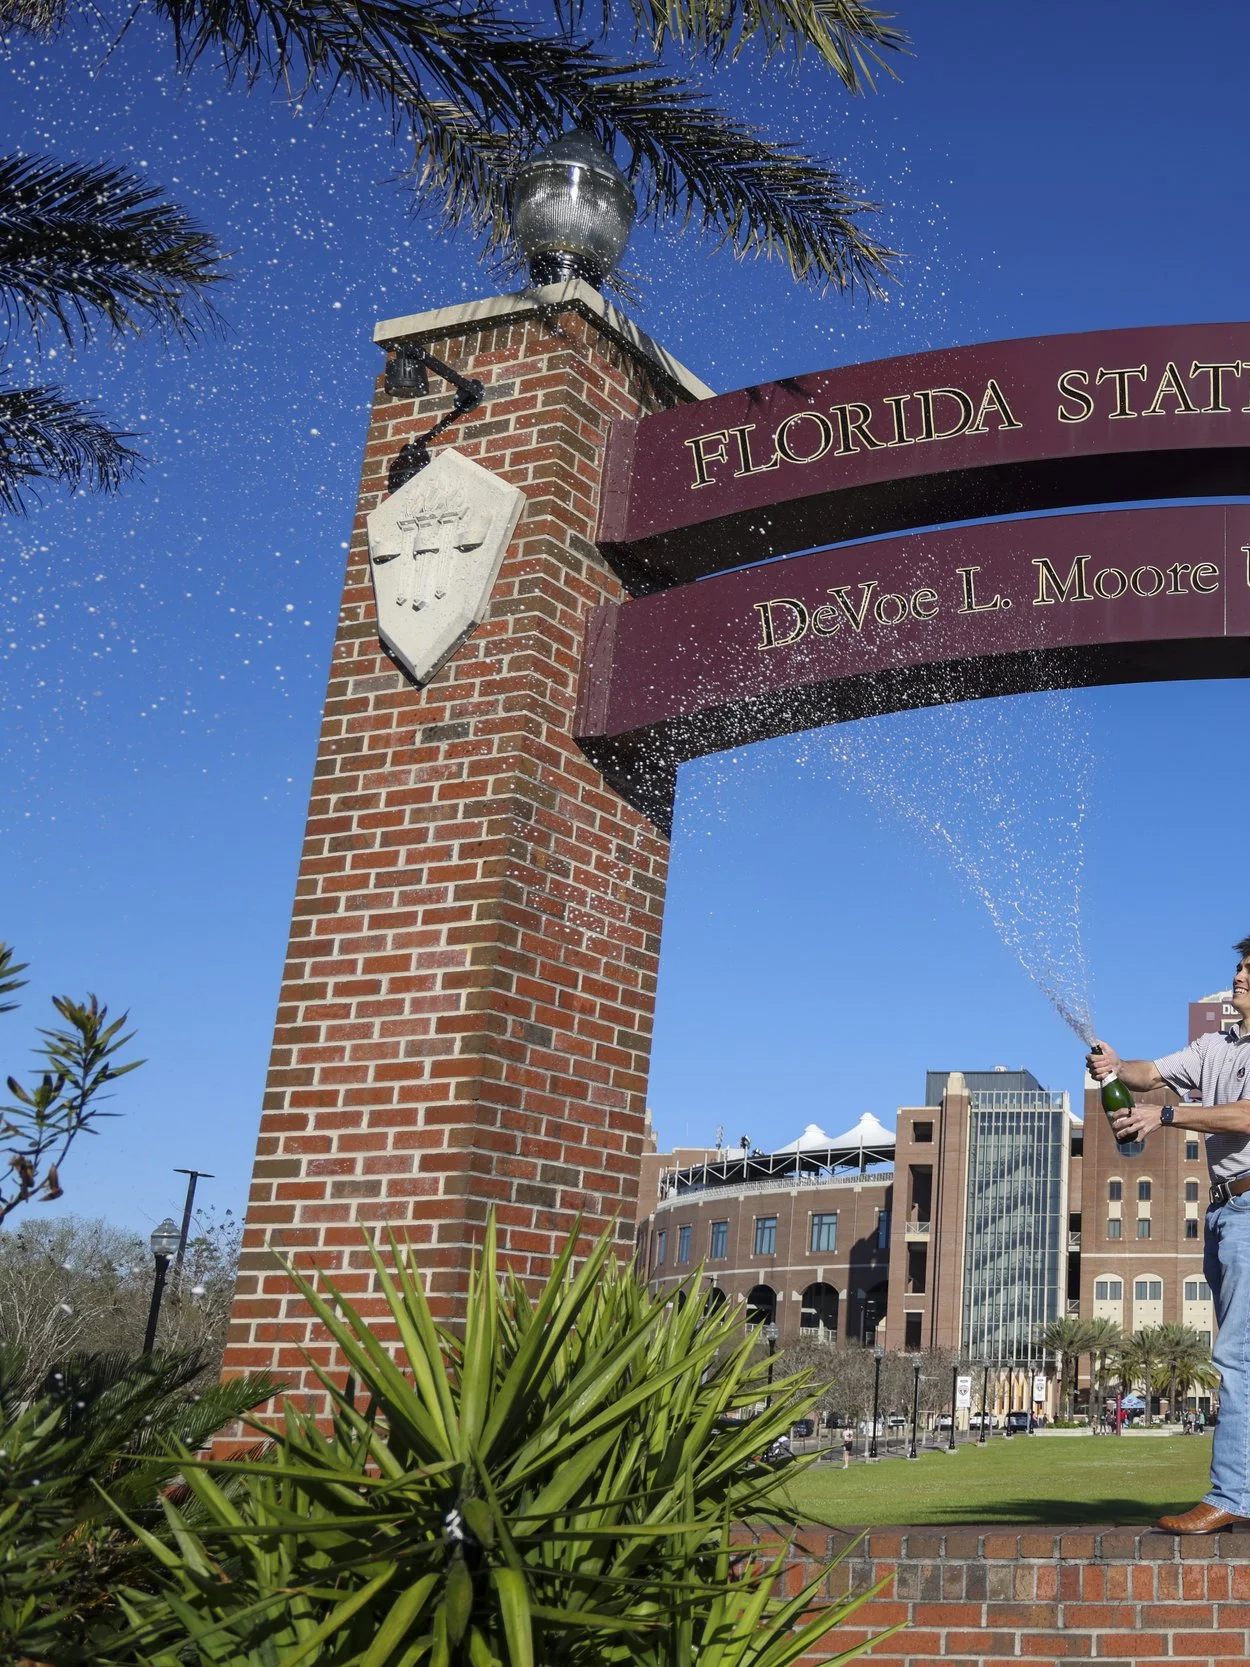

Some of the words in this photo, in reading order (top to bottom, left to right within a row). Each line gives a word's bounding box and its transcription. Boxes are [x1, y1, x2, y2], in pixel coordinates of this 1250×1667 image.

[684, 378, 1023, 489] FLORIDA
[753, 580, 940, 650] DeVoe
[956, 566, 1011, 614] L.
[1032, 555, 1220, 605] Moore
